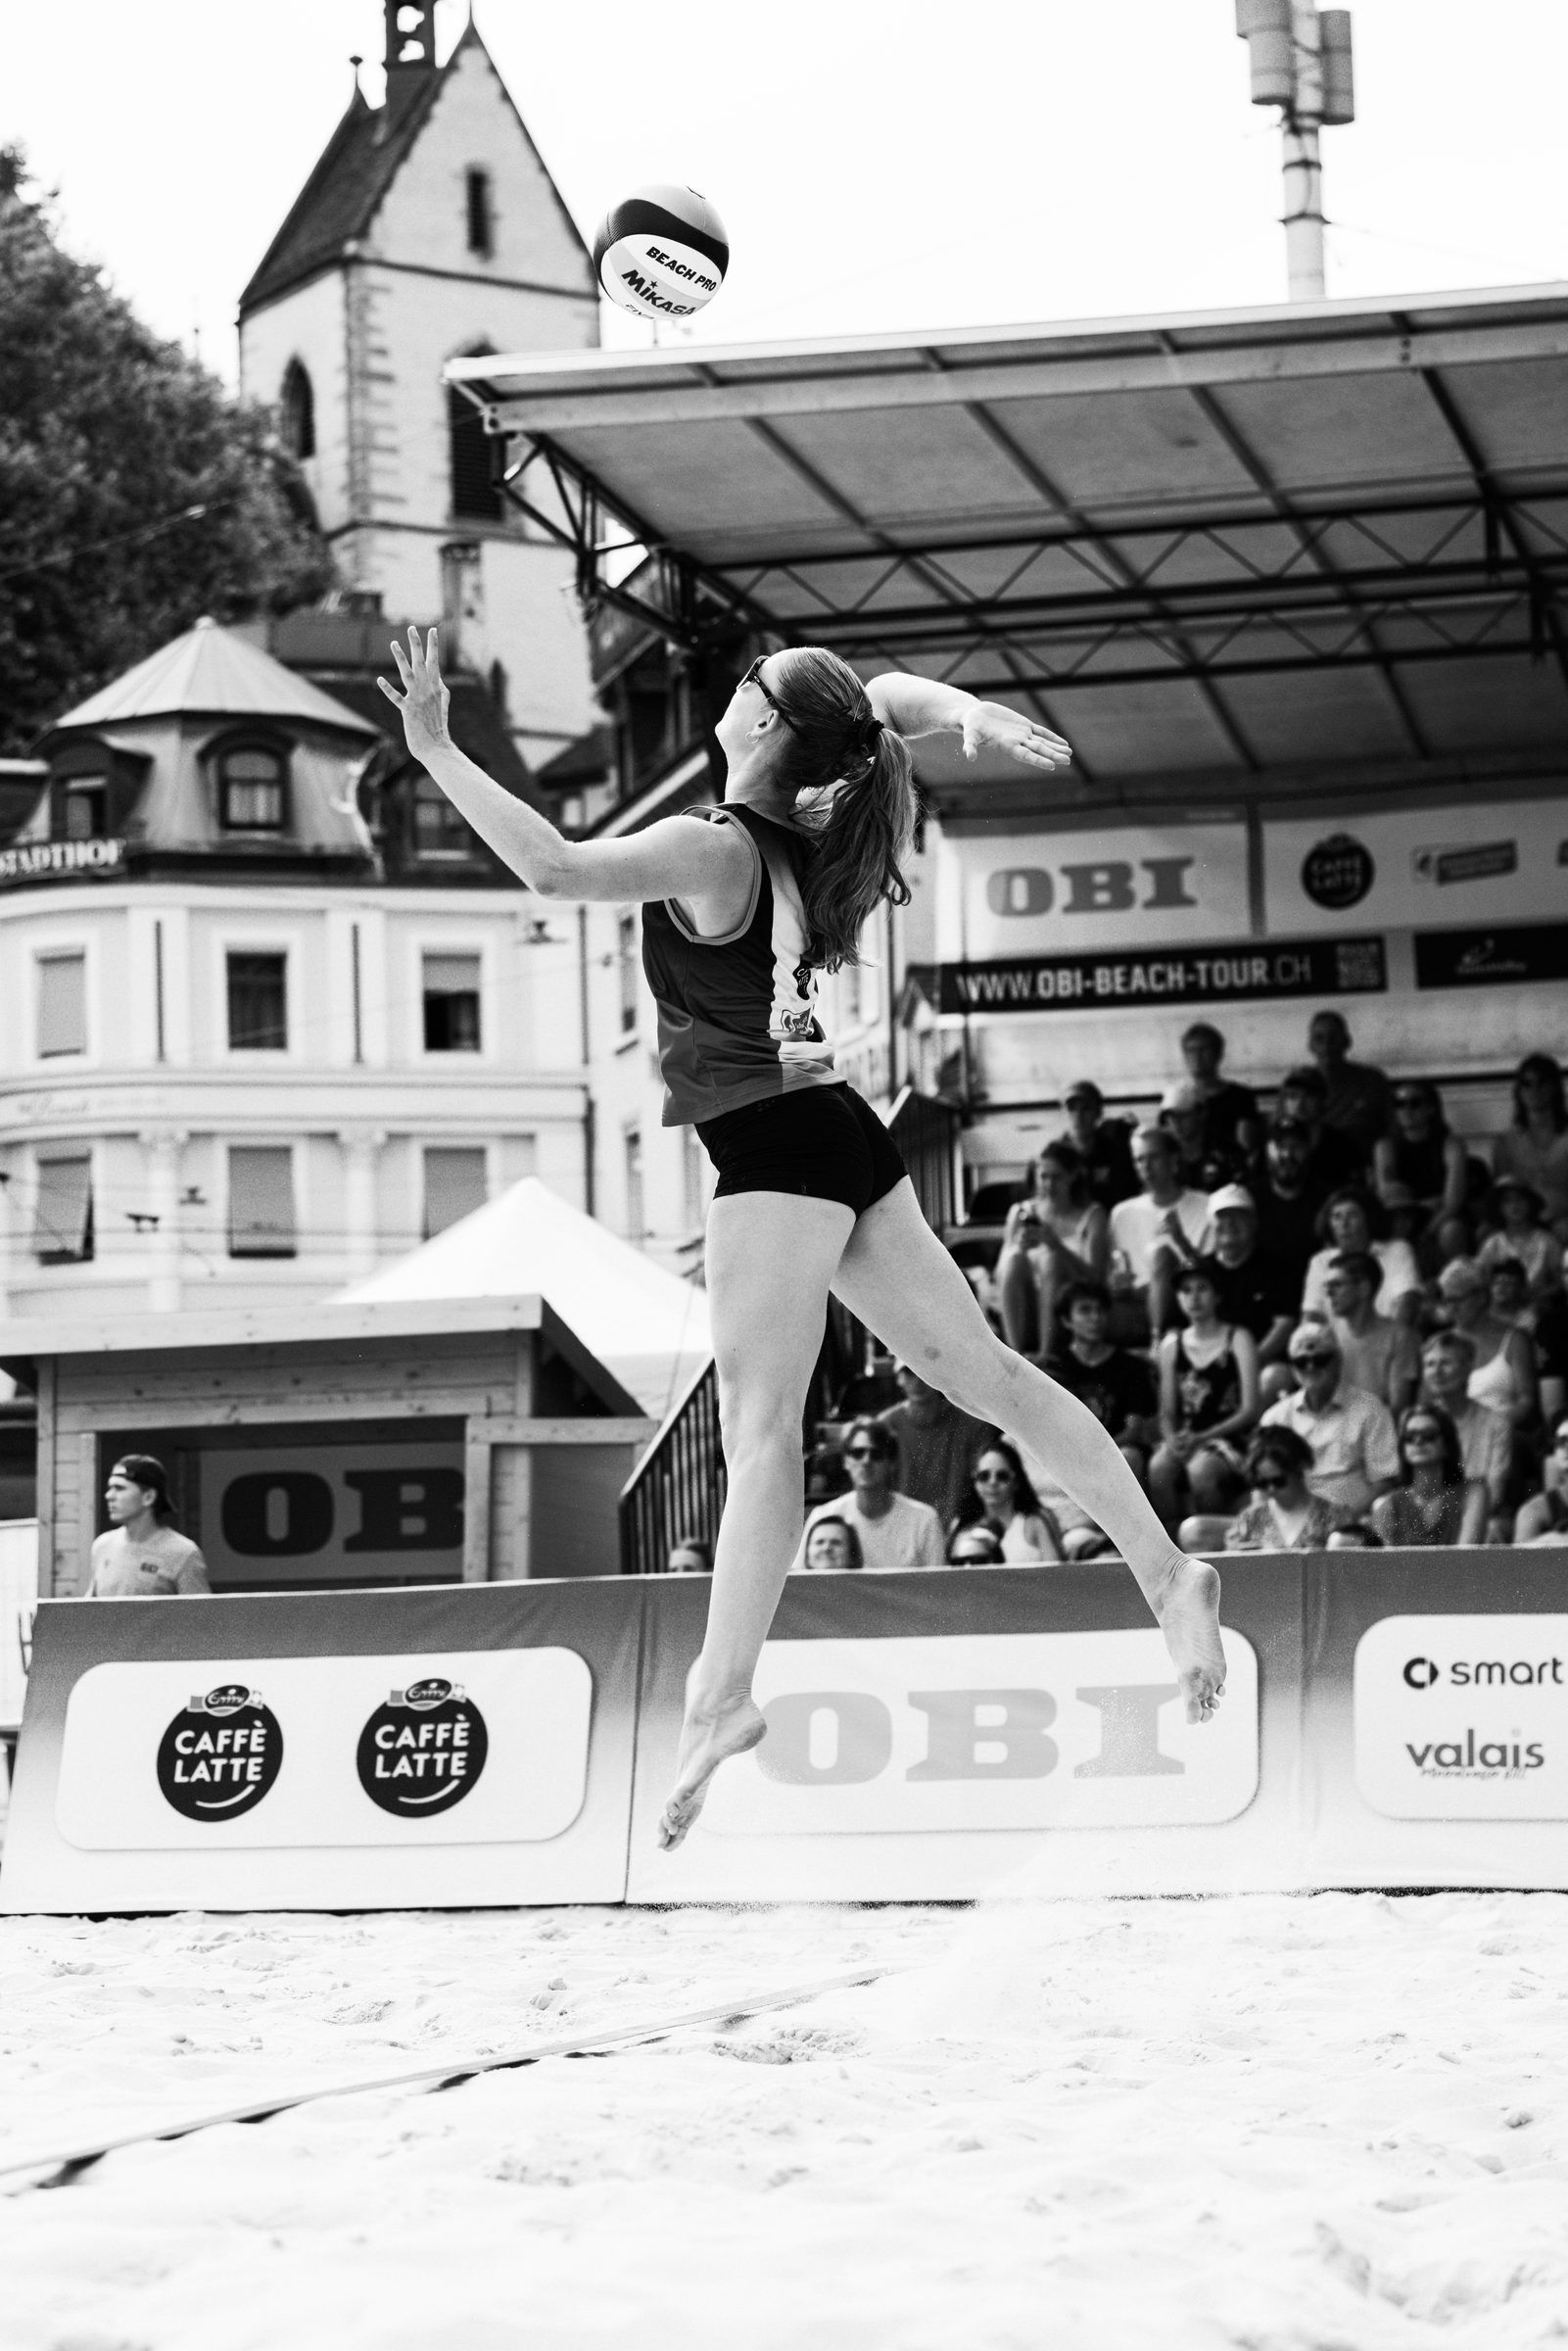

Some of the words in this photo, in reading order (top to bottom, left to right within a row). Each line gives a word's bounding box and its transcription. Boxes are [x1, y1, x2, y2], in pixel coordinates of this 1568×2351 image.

[645, 246, 696, 281] BEACH
[694, 274, 717, 292] PRO
[986, 855, 1197, 918] OBI
[956, 953, 1312, 1003] WWW.OBI-BEACH-TOUR.CH
[221, 1467, 466, 1557] OB
[1450, 1656, 1564, 1686] smart
[174, 1719, 267, 1755] CAFFÈ
[374, 1713, 471, 1750] CAFFÈ
[754, 1683, 1186, 1786] OBI
[1405, 1727, 1544, 1768] valais
[173, 1756, 264, 1783] LATTE
[374, 1751, 469, 1779] LATTE
